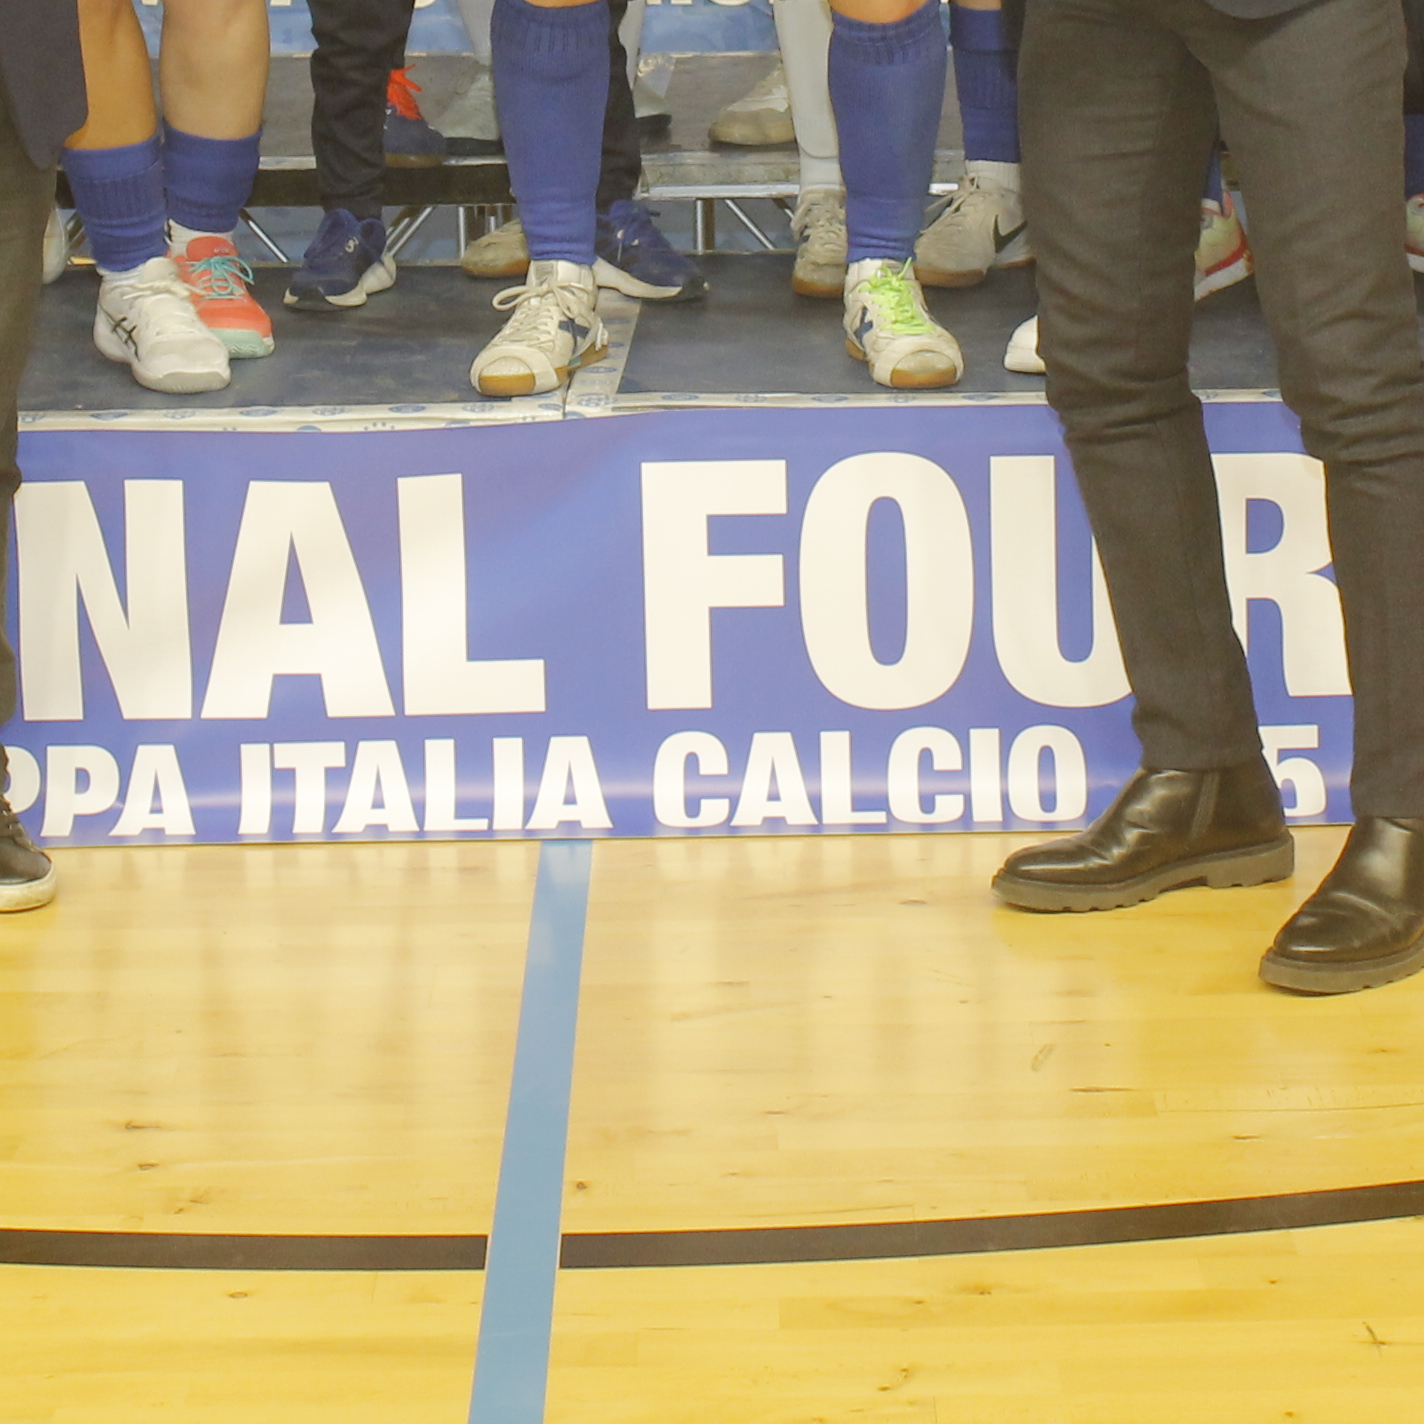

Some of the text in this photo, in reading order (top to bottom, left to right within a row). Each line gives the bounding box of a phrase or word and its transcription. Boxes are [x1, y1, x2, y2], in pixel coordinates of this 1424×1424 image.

[640, 451, 1353, 714] FOUR
[237, 736, 614, 837] ITALIA
[652, 725, 1088, 829] CALCIO
[1258, 724, 1328, 818] 5
